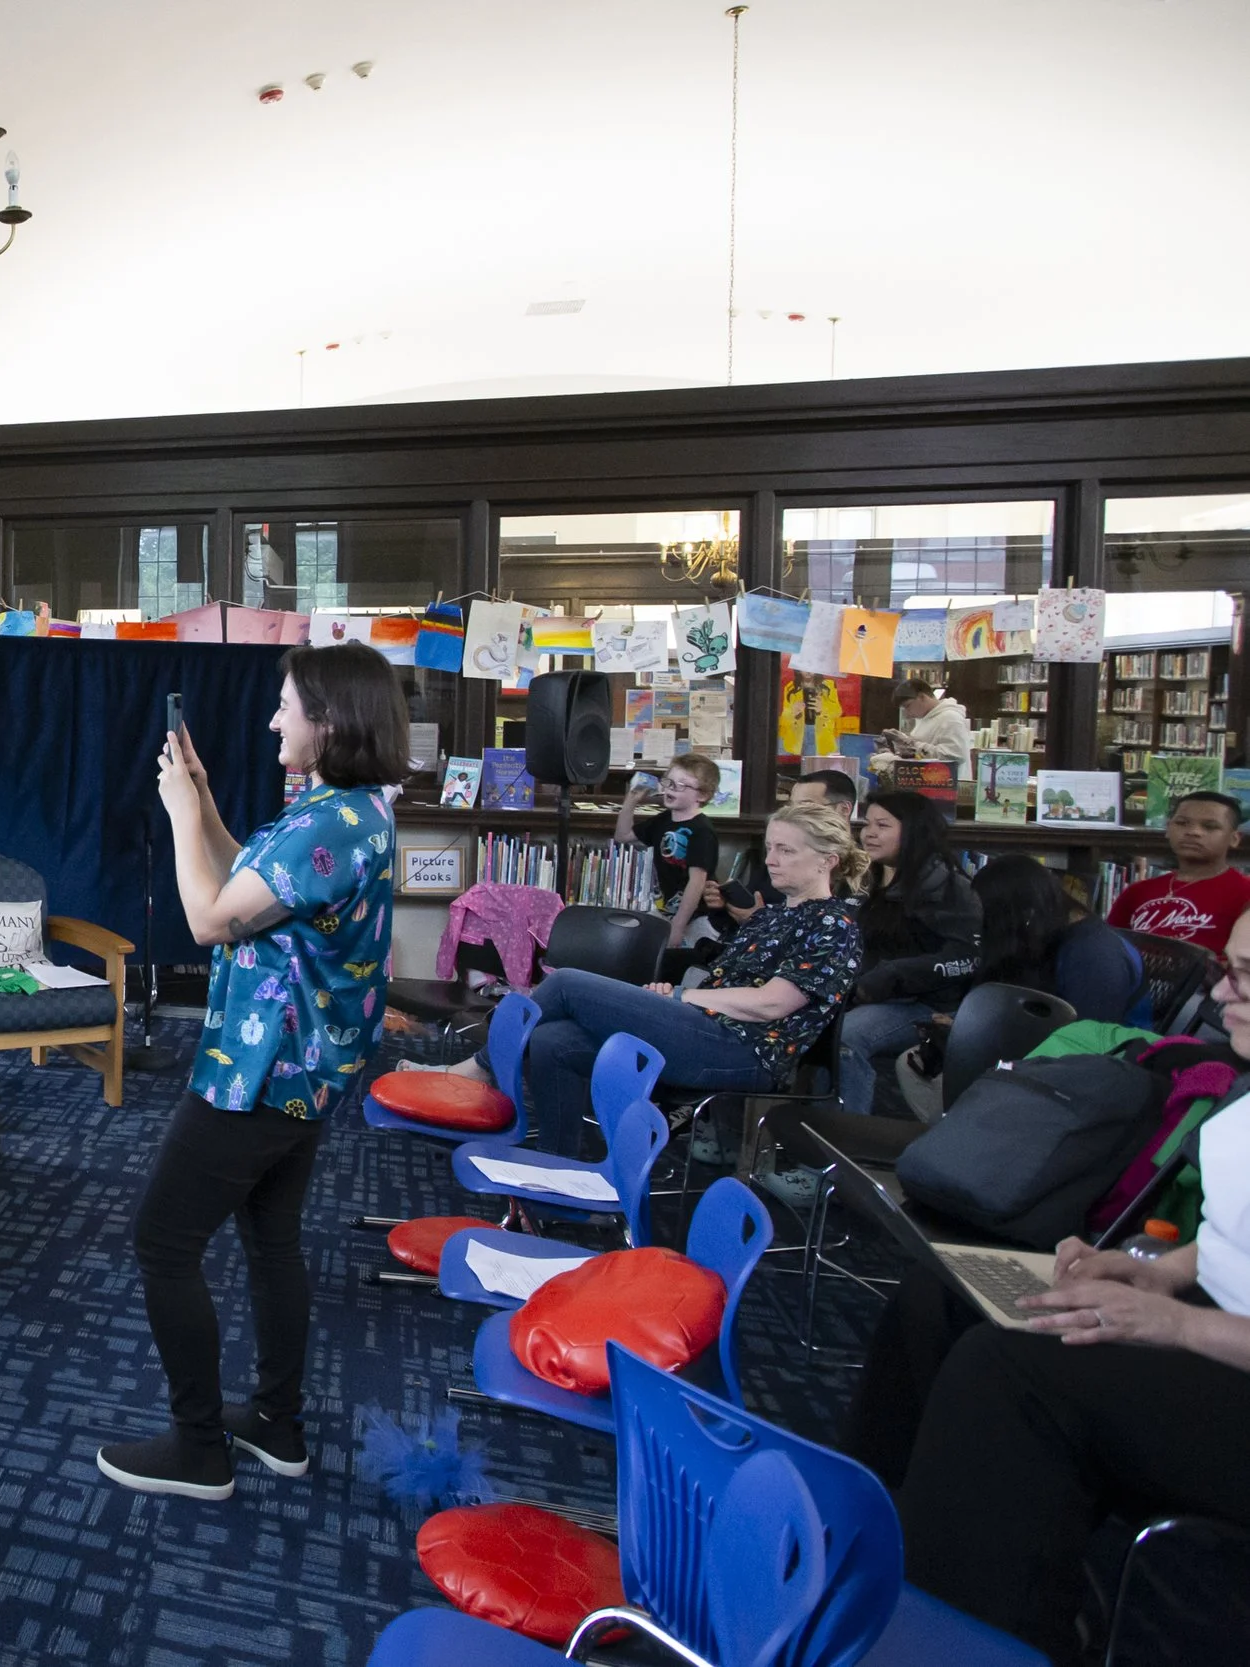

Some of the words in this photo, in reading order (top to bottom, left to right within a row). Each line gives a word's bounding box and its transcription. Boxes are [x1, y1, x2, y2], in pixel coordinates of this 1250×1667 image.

[1169, 772, 1203, 786] TREE
[1164, 786, 1206, 797] HOM
[411, 857, 454, 866] Picture
[415, 872, 451, 881] Books
